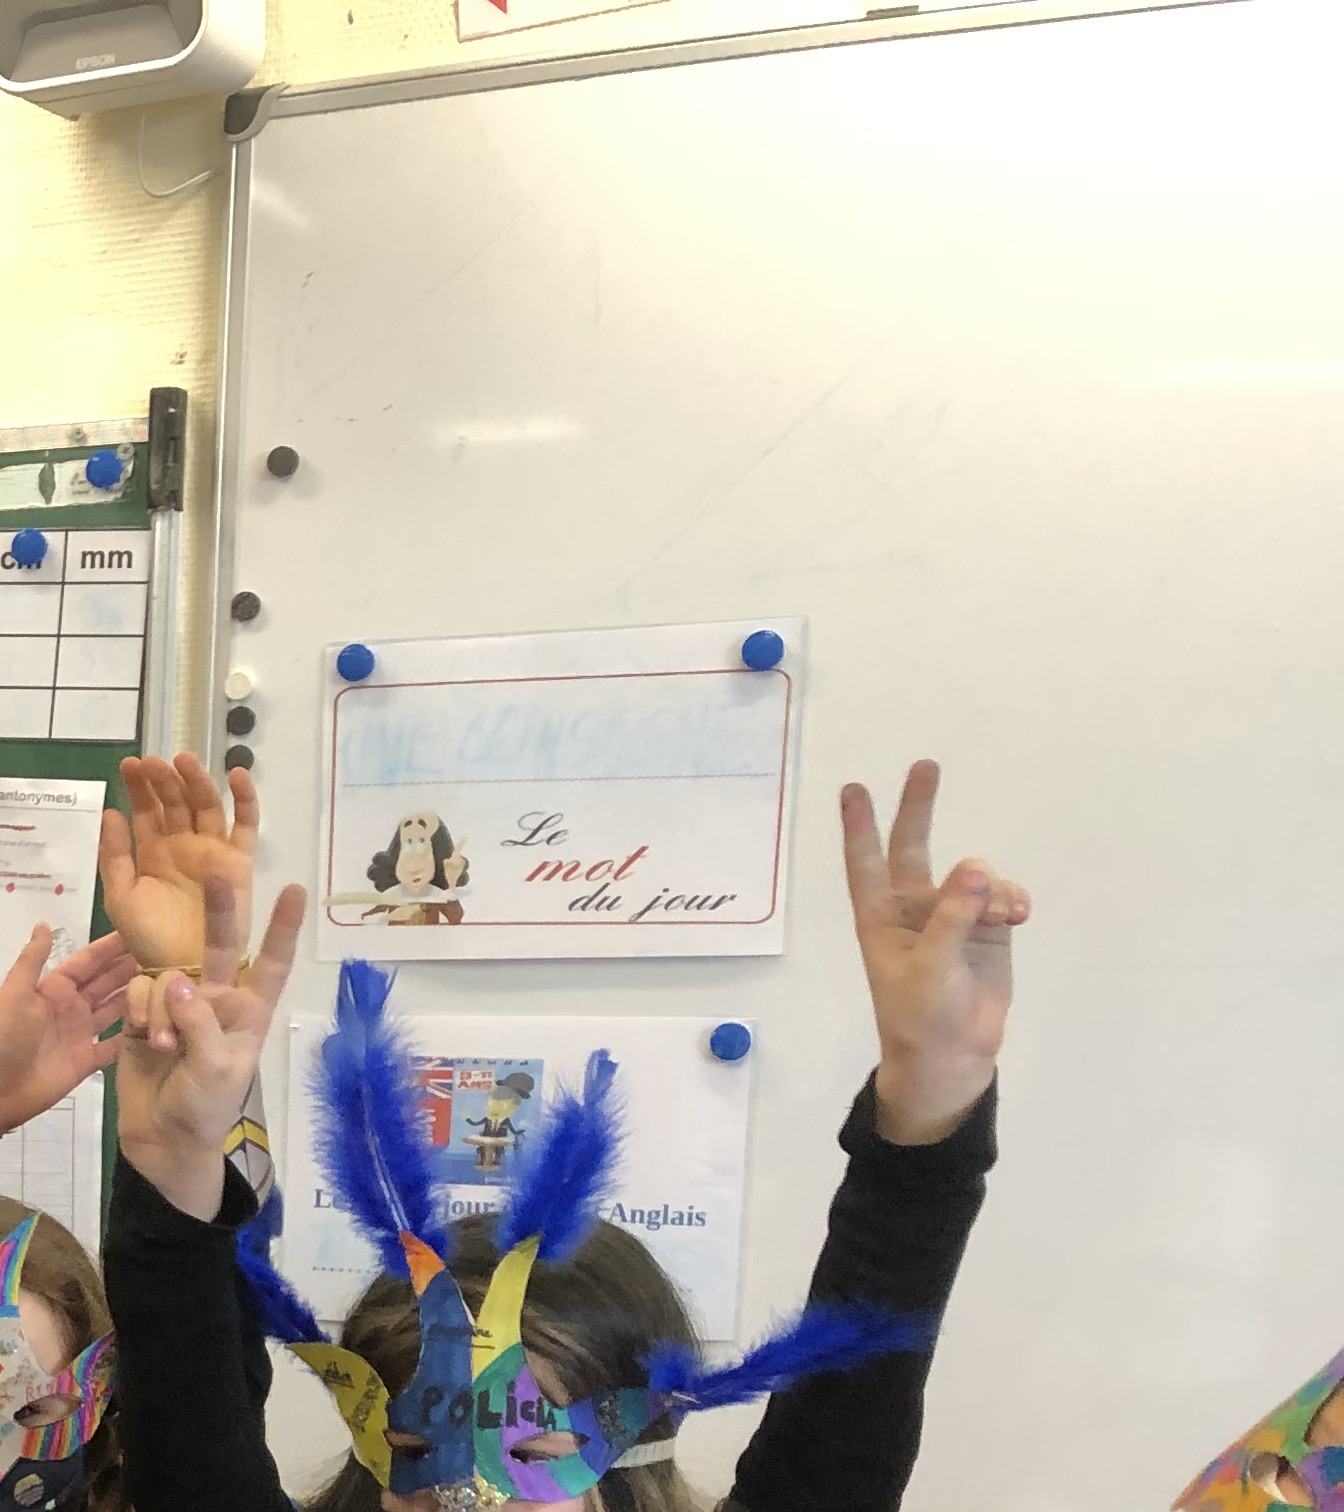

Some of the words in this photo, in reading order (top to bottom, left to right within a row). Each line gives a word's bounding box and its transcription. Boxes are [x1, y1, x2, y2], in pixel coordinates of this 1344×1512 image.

[81, 547, 134, 571] mm
[500, 811, 569, 847] Le
[525, 845, 649, 882] mot
[568, 882, 623, 911] du
[628, 888, 737, 923] jour
[611, 1203, 707, 1230] Anglais
